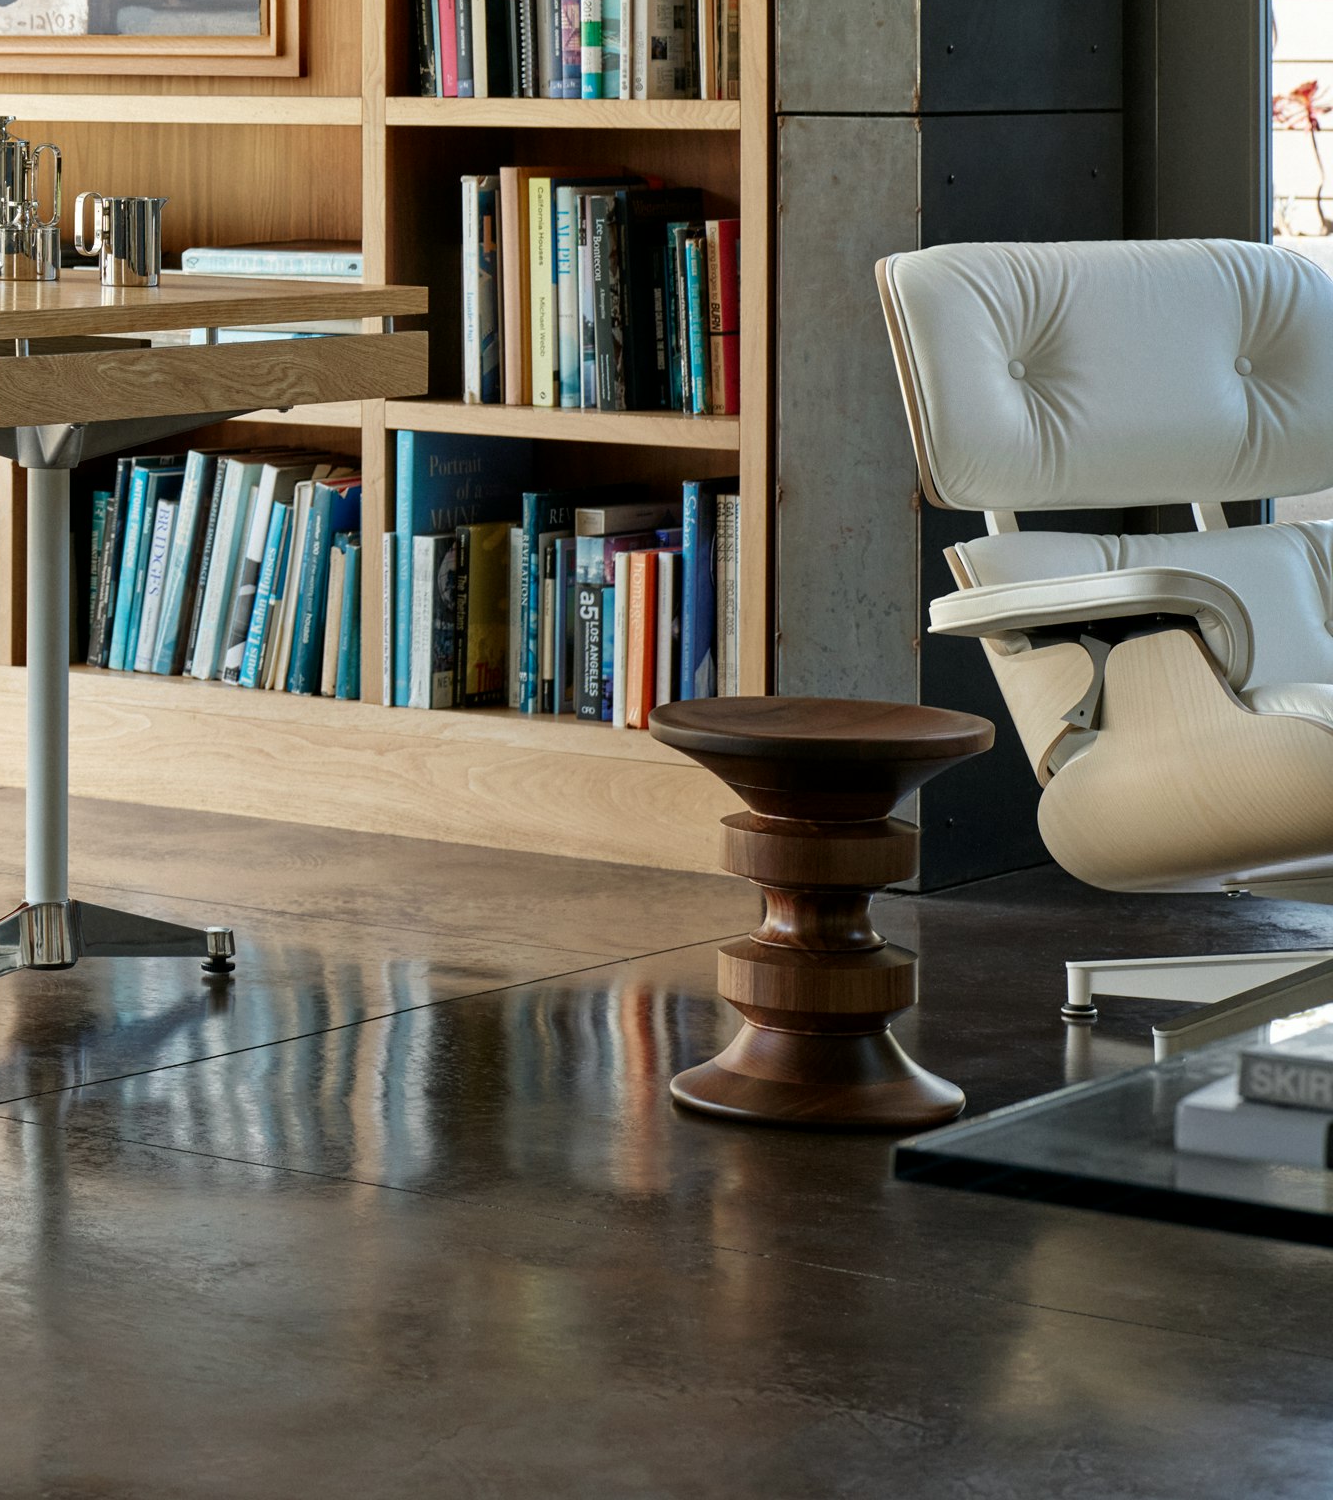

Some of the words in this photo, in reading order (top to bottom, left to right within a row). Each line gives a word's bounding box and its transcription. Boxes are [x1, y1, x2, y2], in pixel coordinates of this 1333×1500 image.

[595, 218, 604, 236] Lee
[708, 226, 718, 262] Designing
[557, 247, 570, 275] PEI
[592, 236, 602, 281] Bontecou
[709, 264, 718, 291] Bridges
[711, 302, 721, 331] BURN
[429, 452, 482, 477] Portrait
[132, 478, 144, 521] ANTOINE
[726, 501, 734, 519] GA
[683, 495, 697, 548] Sahara
[147, 507, 170, 597] BRIDGES
[312, 541, 320, 555] 100
[726, 521, 734, 563] HOUSES
[258, 547, 276, 596] Houses
[458, 574, 467, 591] The
[521, 534, 529, 606] REVELATION
[457, 593, 467, 631] Tibetans
[580, 591, 599, 620] a5
[726, 579, 734, 616] PROJECT
[251, 599, 268, 635] Kahn
[303, 613, 312, 644] houses
[589, 621, 599, 643] LOS
[241, 646, 259, 685] Louis
[589, 645, 599, 697] ANGELES
[1249, 1062, 1333, 1100] SKIR
